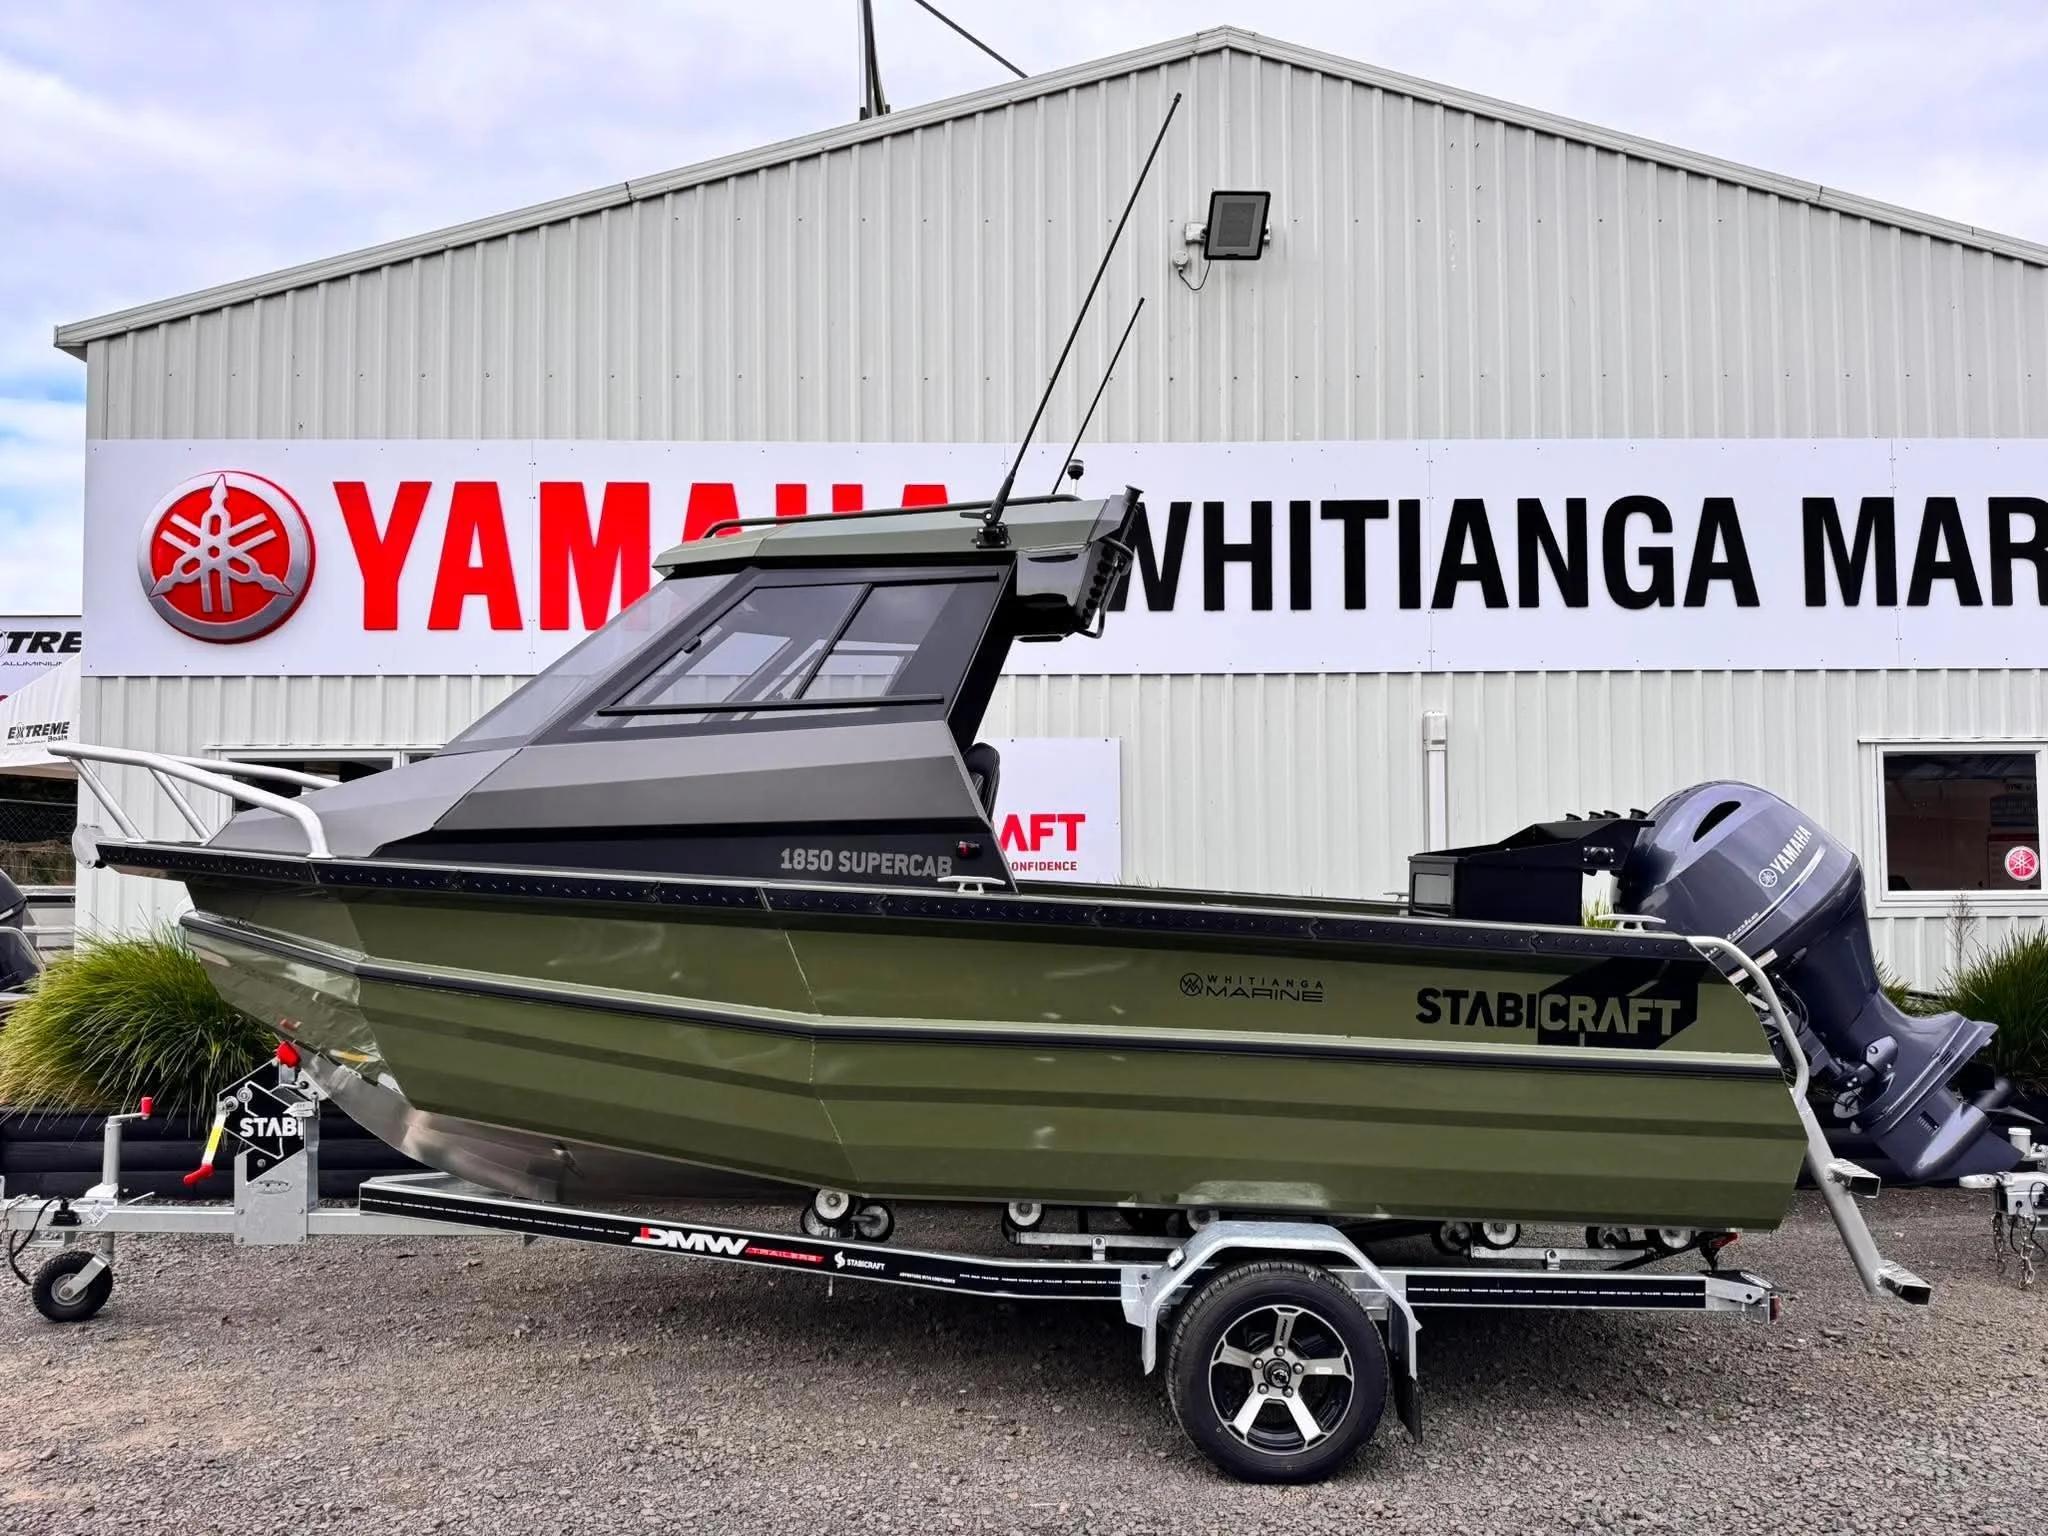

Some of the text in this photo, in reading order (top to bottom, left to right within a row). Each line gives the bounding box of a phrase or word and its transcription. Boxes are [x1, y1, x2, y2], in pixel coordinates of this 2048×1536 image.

[333, 481, 2048, 631] YAM WHITIANGA MAR
[0, 631, 82, 653] TRE
[7, 721, 70, 739] EXTREME
[993, 813, 1086, 851] AFT
[780, 848, 952, 877] 1850 SUPERCAB
[1769, 824, 1812, 874] YAMAHA
[1007, 861, 1078, 871] ONFIDENCE
[1206, 986, 1323, 1002] MARINE
[1207, 974, 1323, 989] WHITIANGA
[1415, 987, 1681, 1036] STABICRAFT
[631, 1227, 749, 1256] DMW
